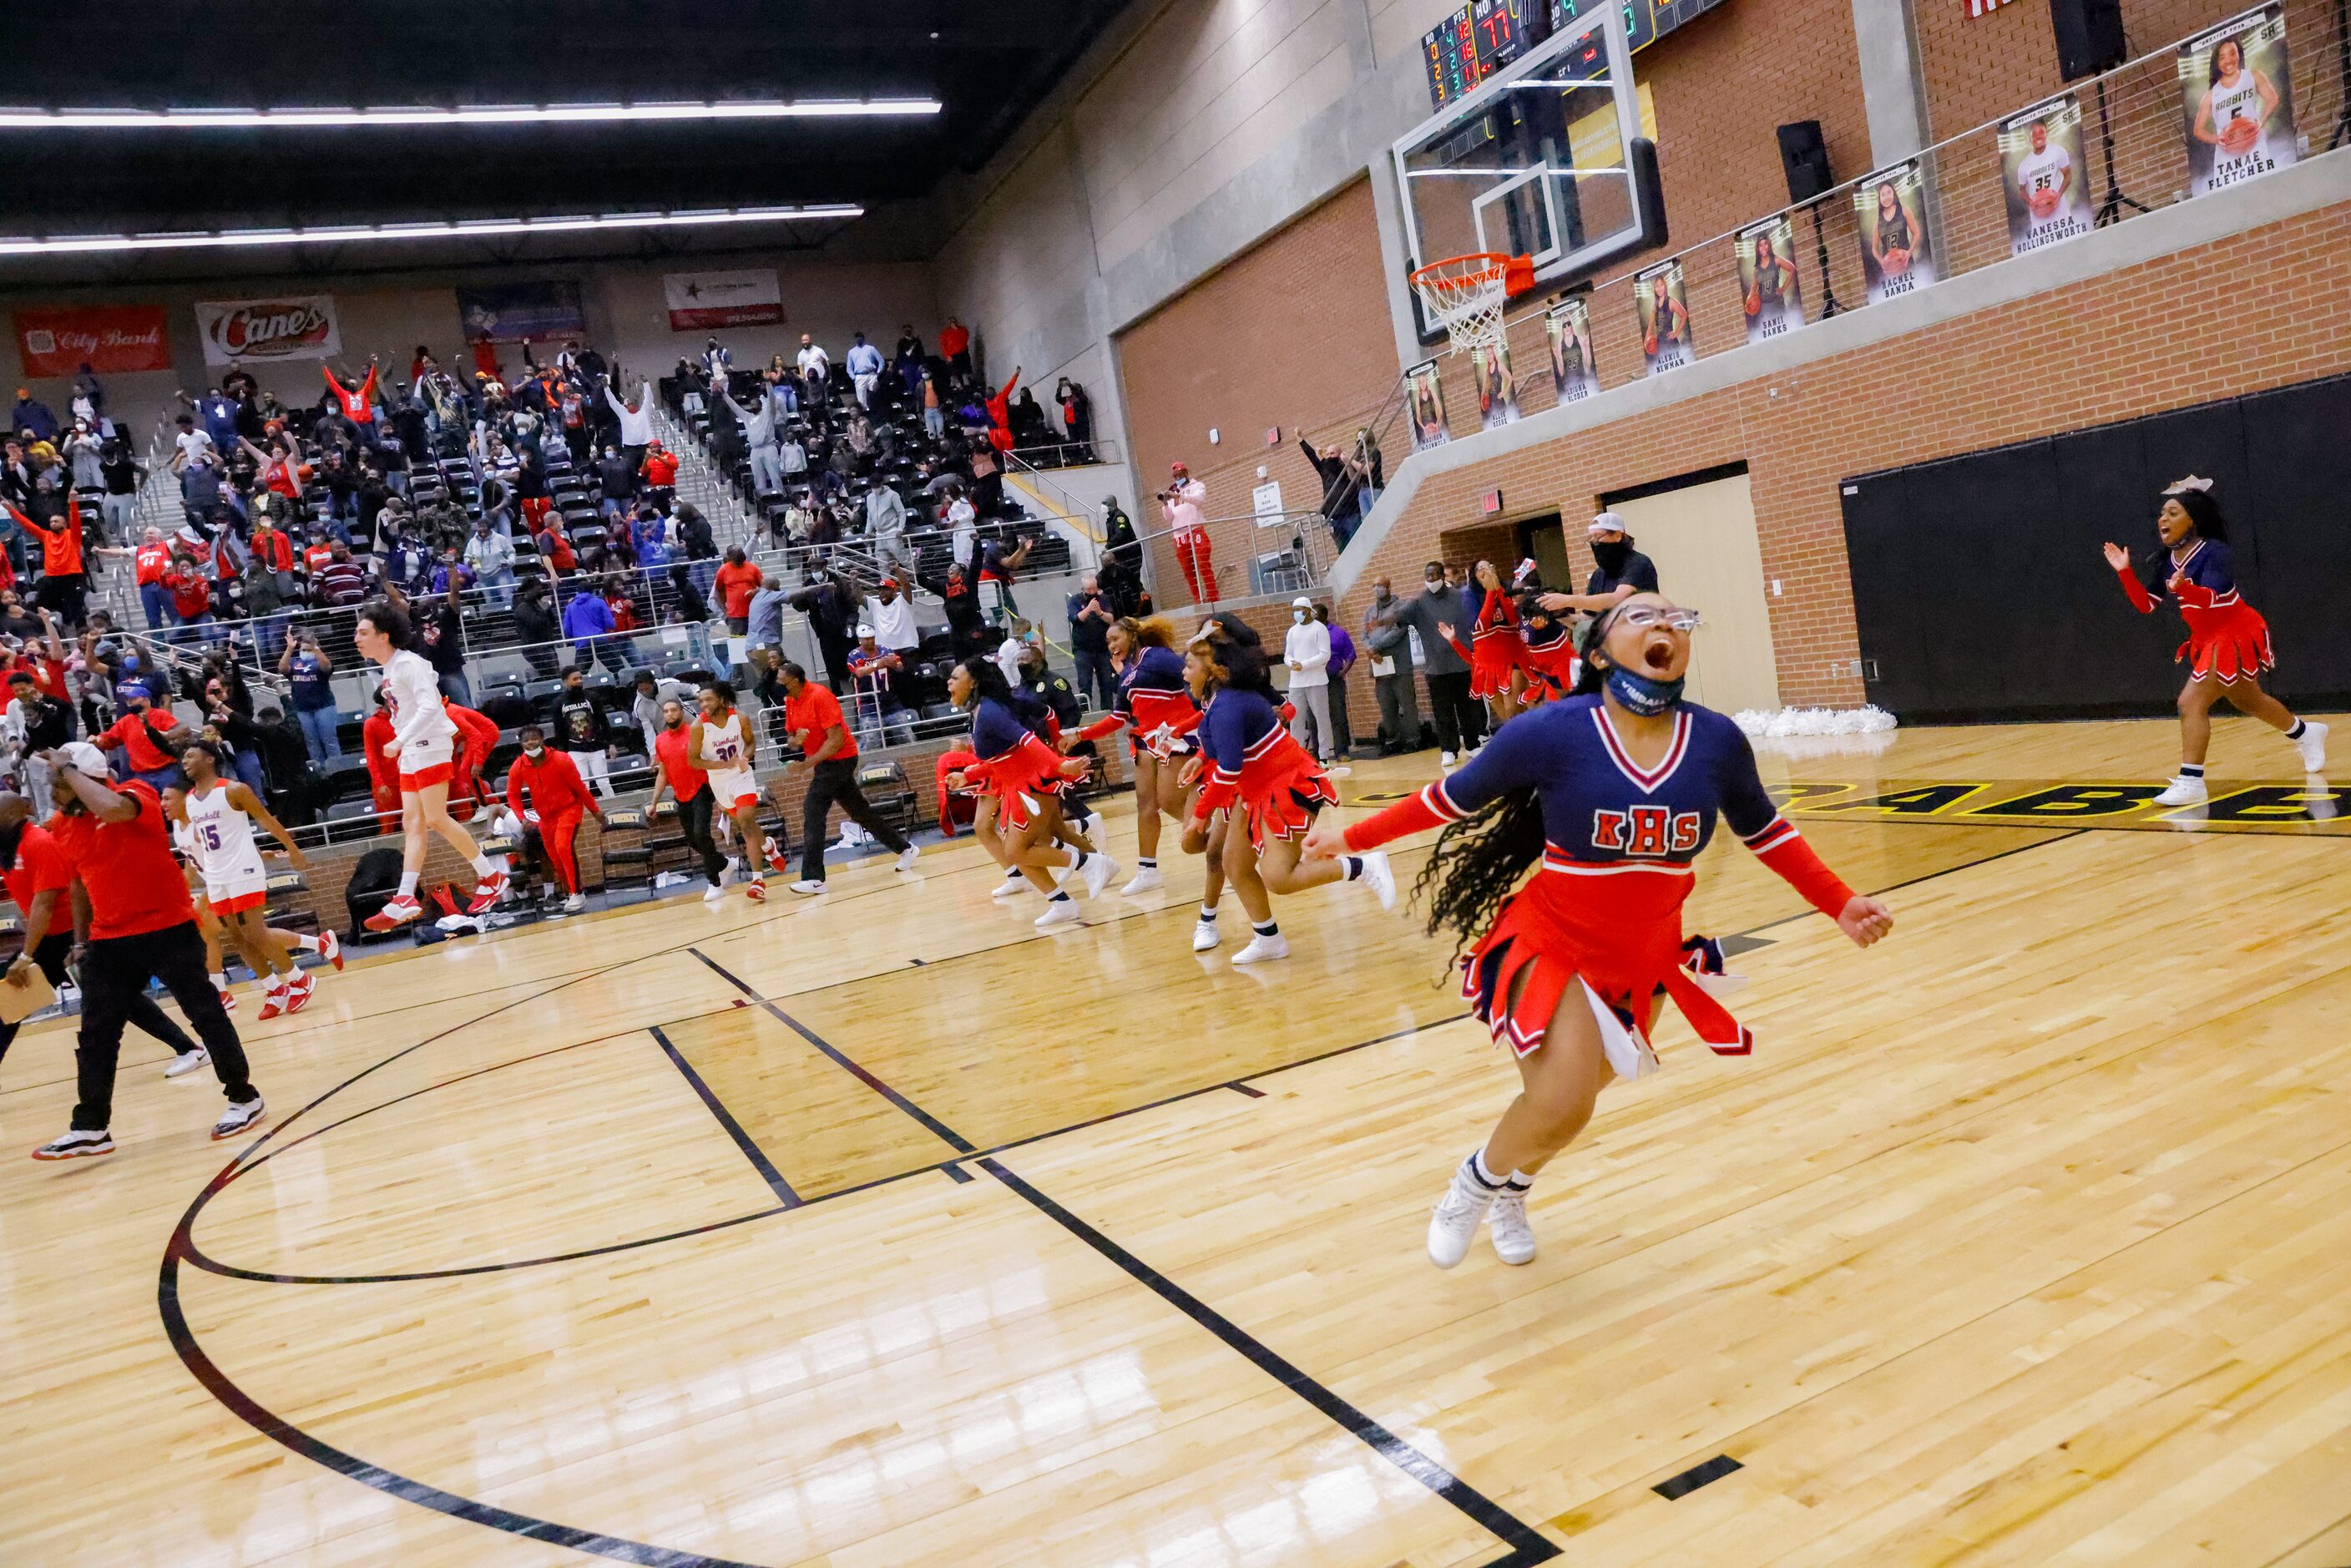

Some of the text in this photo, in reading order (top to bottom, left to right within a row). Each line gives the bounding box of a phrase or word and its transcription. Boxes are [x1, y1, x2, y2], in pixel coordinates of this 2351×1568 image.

[1454, 9, 1466, 25] PTS
[1442, 23, 1446, 33] F
[1458, 20, 1469, 40] 12
[1483, 8, 1510, 48] 77
[1426, 33, 1434, 46] NO
[1446, 31, 1454, 47] 4
[1431, 43, 1438, 60] 0
[1461, 42, 1474, 60] 16
[1449, 53, 1456, 69] 2
[1434, 64, 1440, 80] 2
[1464, 62, 1476, 81] 11
[1453, 73, 1459, 90] 3
[1438, 83, 1444, 100] 3
[2215, 88, 2253, 112] RABBITS
[2217, 150, 2260, 175] TANAE
[2035, 174, 2051, 192] 35
[2208, 159, 2275, 190] FLETCHER
[2026, 215, 2075, 240] VANESSA
[2017, 222, 2087, 253] HOLLINGSWORTH
[1882, 271, 1914, 290] RACHEL
[1885, 281, 1914, 298] BANDA
[1762, 316, 1784, 329] SANII
[1762, 323, 1787, 338] BANKS
[56, 326, 160, 355] City Bank
[1656, 358, 1685, 374] NEWMAN
[1658, 351, 1681, 365] ALEXIS
[712, 734, 739, 748] Kimball
[191, 810, 221, 824] Kimball
[200, 824, 221, 852] 15
[1592, 805, 1701, 856] KHS
